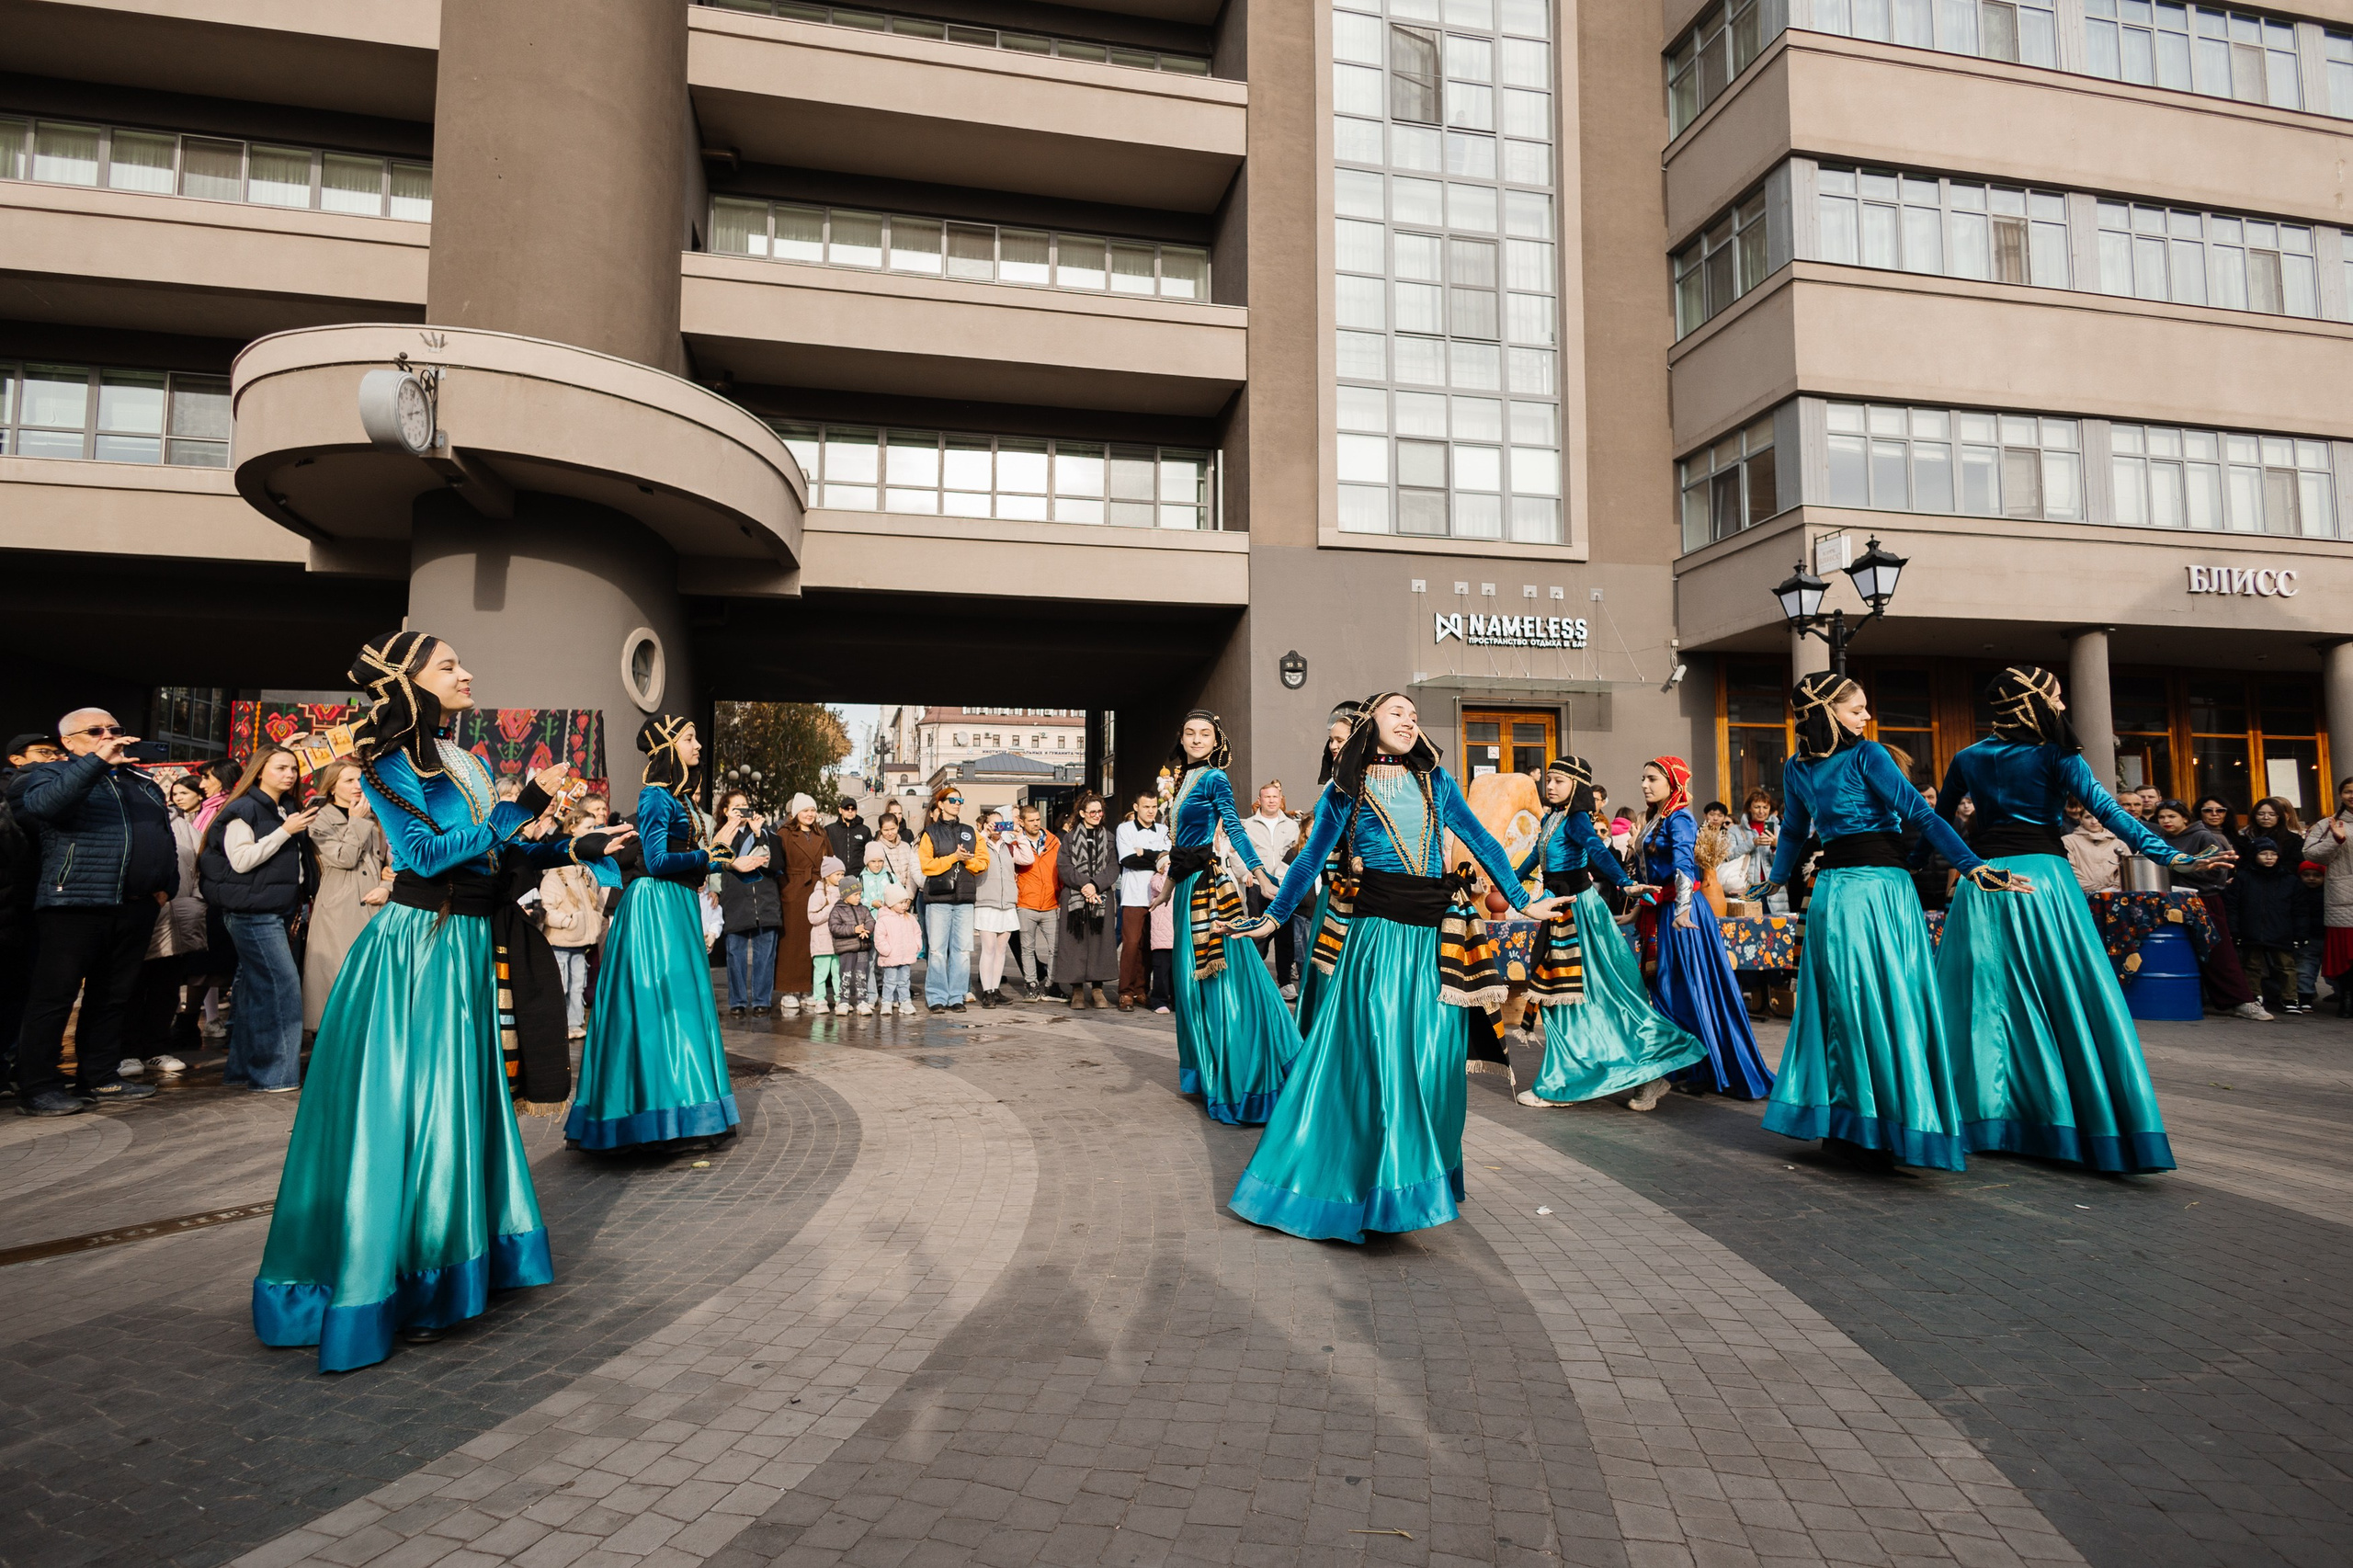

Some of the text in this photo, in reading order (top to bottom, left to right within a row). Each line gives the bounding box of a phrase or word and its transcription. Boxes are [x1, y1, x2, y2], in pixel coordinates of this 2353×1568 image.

[2187, 564, 2299, 597] БЛИСС
[1469, 613, 1588, 639] NAMELESS
[1468, 637, 1528, 645] ПРОСТРАНСТВО
[1529, 639, 1562, 648] ОТДЫХА
